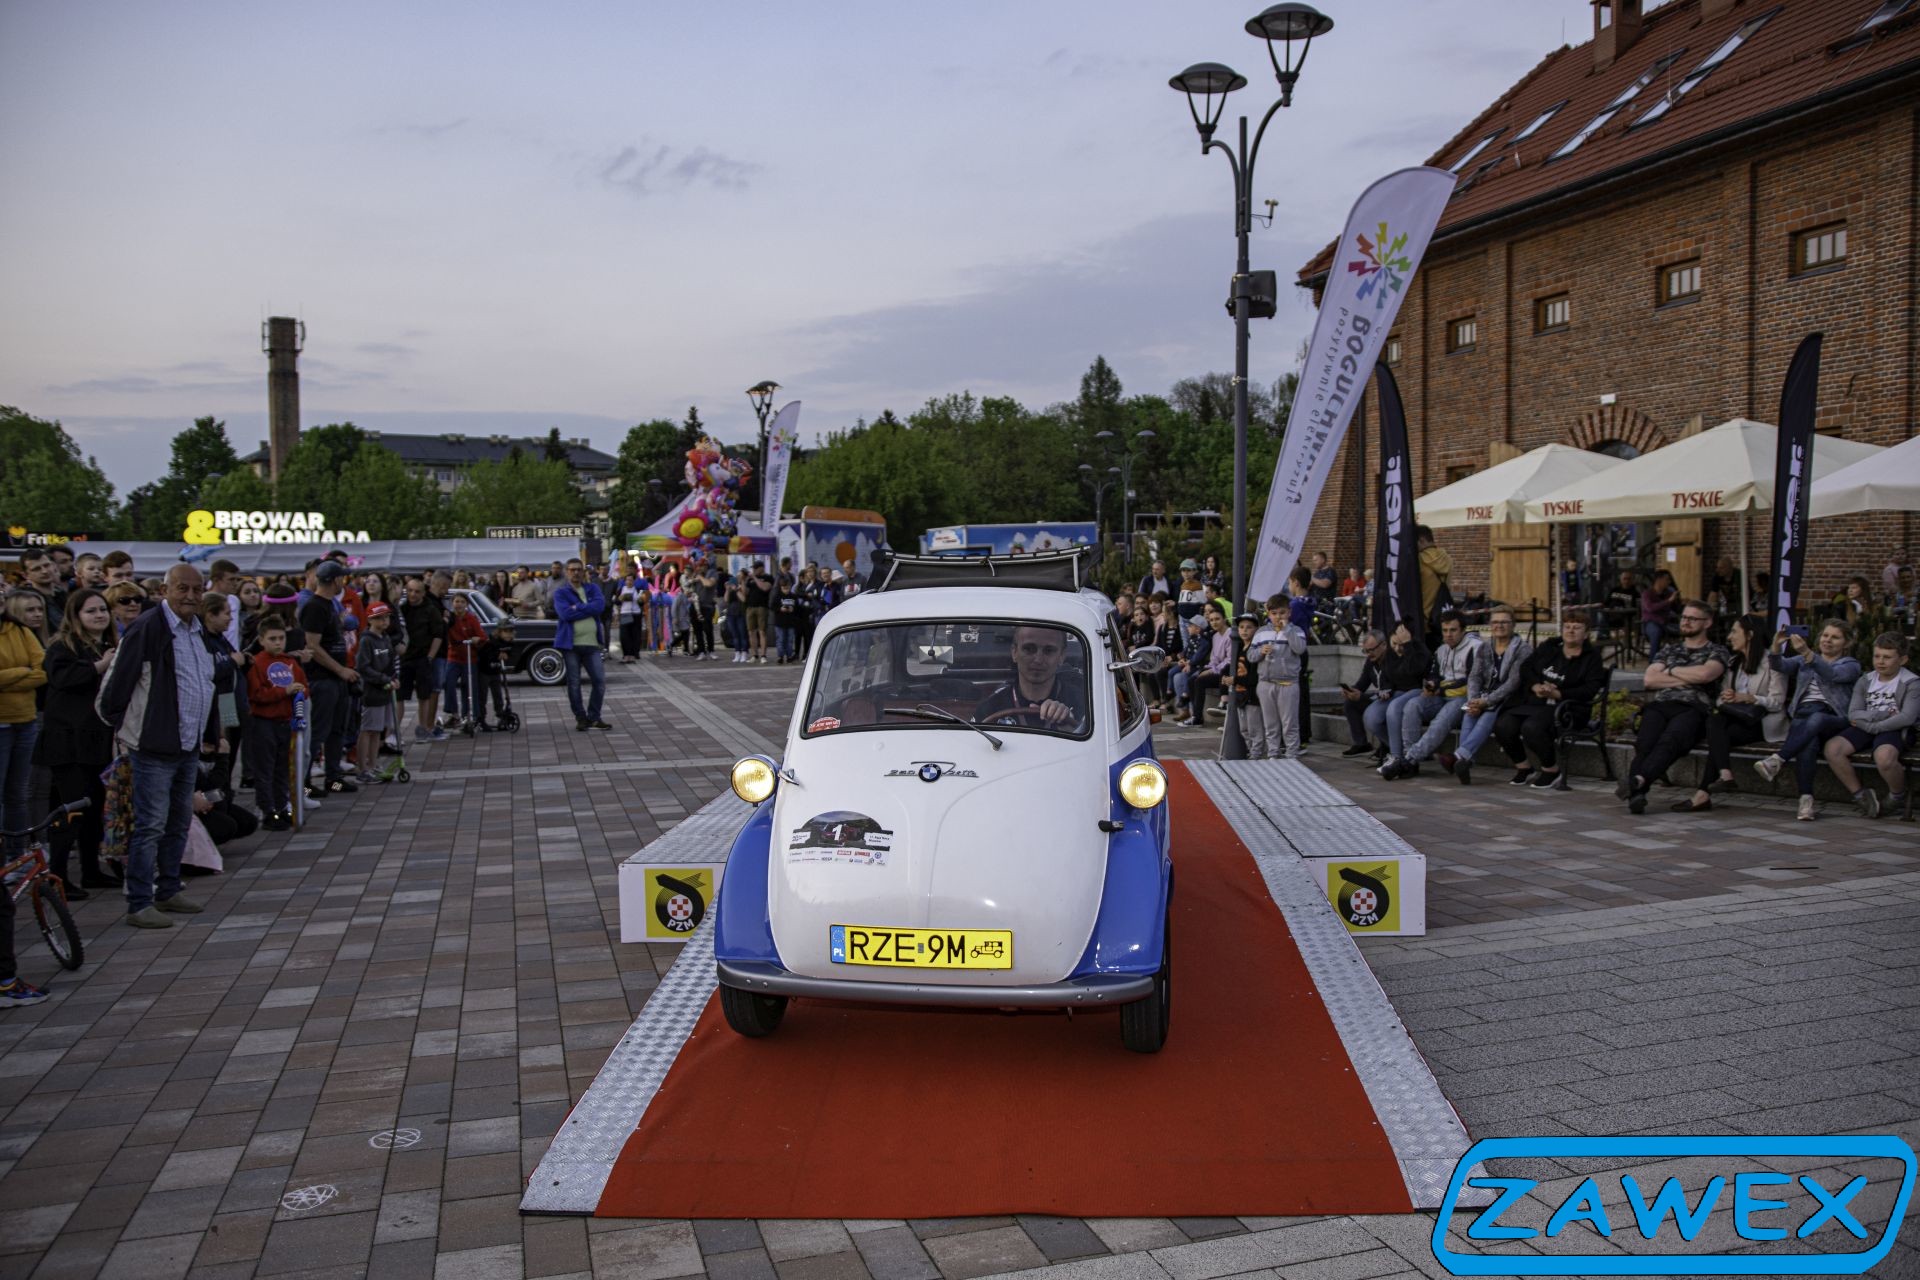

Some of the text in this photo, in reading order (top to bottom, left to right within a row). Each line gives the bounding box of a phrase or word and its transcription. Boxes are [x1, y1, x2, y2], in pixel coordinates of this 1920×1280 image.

[1315, 307, 1349, 401] pozytywnie
[1671, 490, 1725, 508] TYSKIE
[1466, 506, 1494, 520] TYSKIE
[1542, 499, 1585, 517] TYSKIE
[214, 510, 326, 530] BROWAR
[224, 528, 371, 544] LEMONIADA
[490, 527, 581, 538] HOUSE BURGER
[832, 824, 843, 841] 1
[666, 918, 695, 932] PZM
[1349, 912, 1379, 926] PZM
[833, 930, 966, 964] PL RZE 9M
